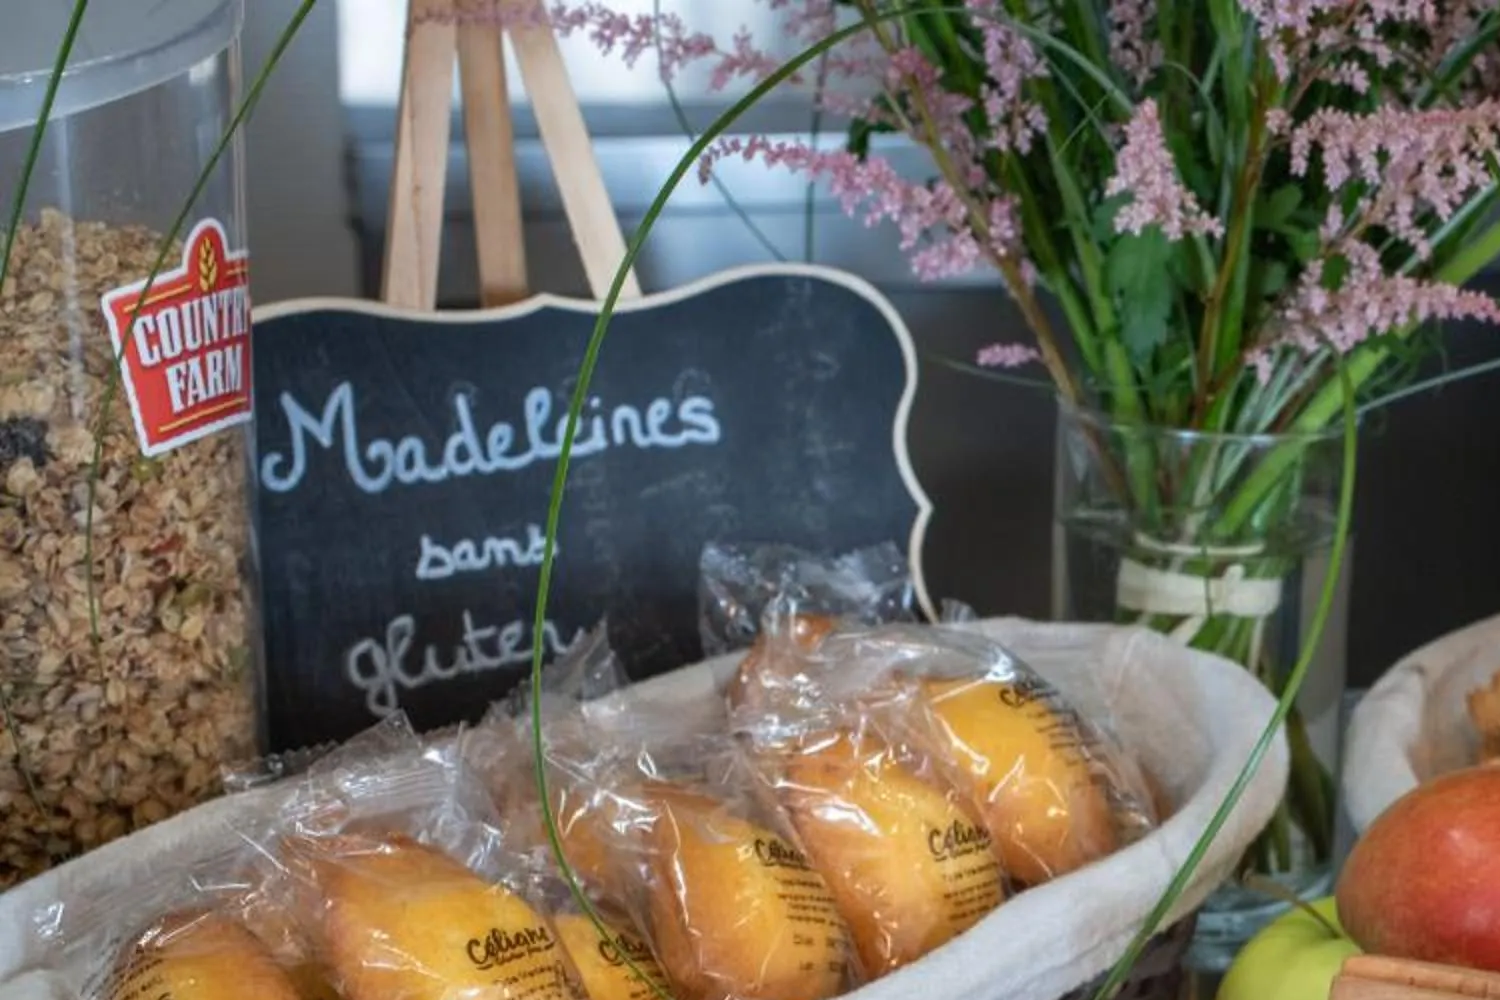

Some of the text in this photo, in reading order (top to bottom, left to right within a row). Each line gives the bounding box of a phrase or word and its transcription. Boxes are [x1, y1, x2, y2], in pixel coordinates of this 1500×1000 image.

[132, 284, 250, 368] COUNTR
[164, 342, 245, 414] FARM
[260, 380, 723, 494] Madeleines
[415, 522, 560, 581] sans
[346, 608, 587, 724] gluten
